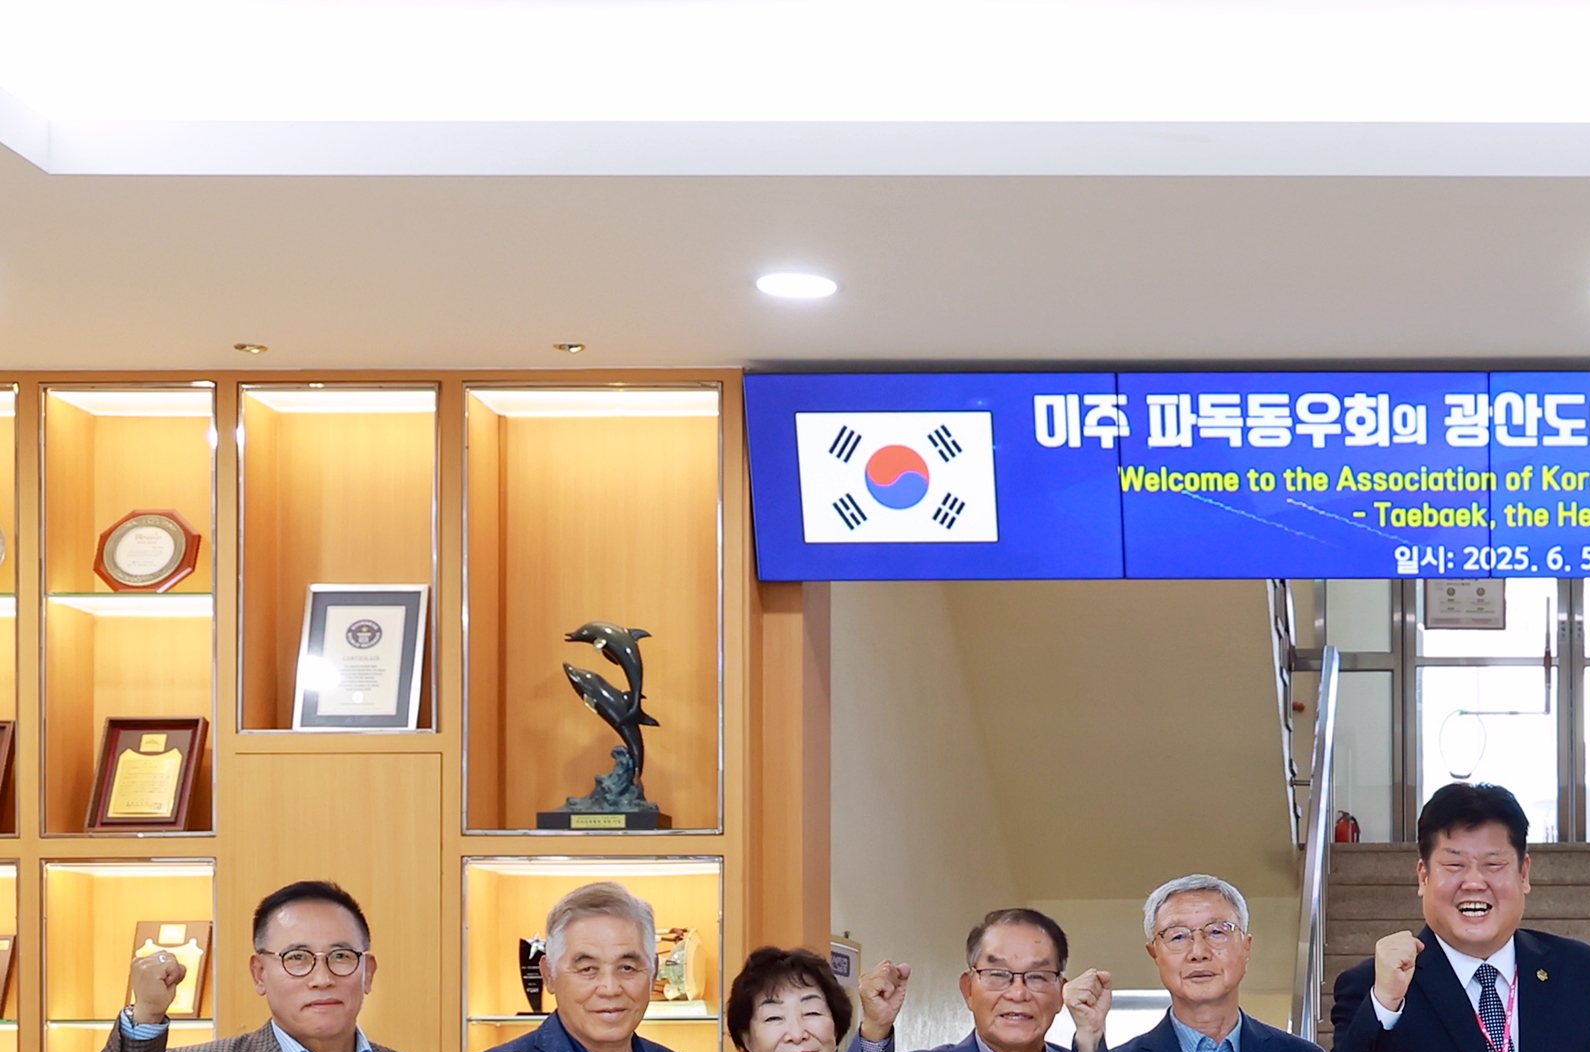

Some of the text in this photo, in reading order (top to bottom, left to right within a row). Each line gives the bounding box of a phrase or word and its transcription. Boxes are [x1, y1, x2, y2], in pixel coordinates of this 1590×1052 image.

[1034, 394, 1130, 449] 미주
[1146, 393, 1427, 448] 파독동우회의
[1118, 466, 1239, 492] Welcome
[1247, 469, 1275, 492] to
[1284, 467, 1329, 492] the
[1337, 466, 1497, 492] Association
[1506, 465, 1533, 491] of
[1375, 501, 1496, 530] Taebaek,
[1505, 503, 1549, 527] the
[1394, 545, 1454, 574] 일시:
[1463, 546, 1538, 572] 2025.
[1546, 546, 1571, 572] 6.
